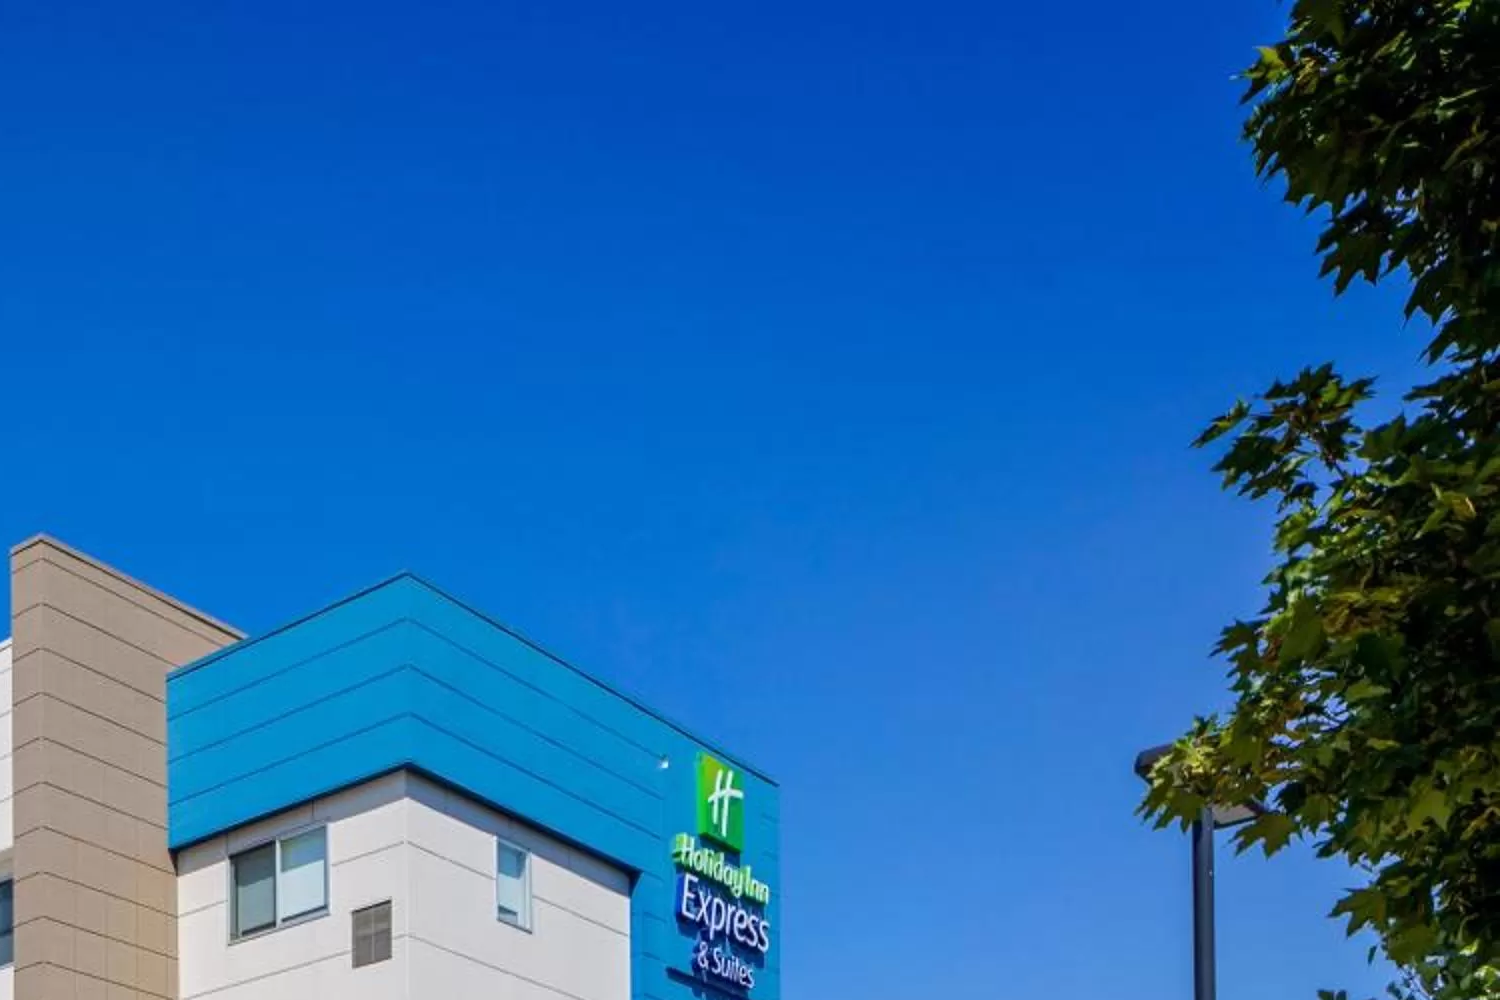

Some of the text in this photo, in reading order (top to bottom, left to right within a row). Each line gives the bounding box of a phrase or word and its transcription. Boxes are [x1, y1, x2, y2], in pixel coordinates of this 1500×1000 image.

[673, 833, 769, 904] Holiday Inn
[681, 872, 770, 953] Express
[697, 941, 756, 989] & Suites
